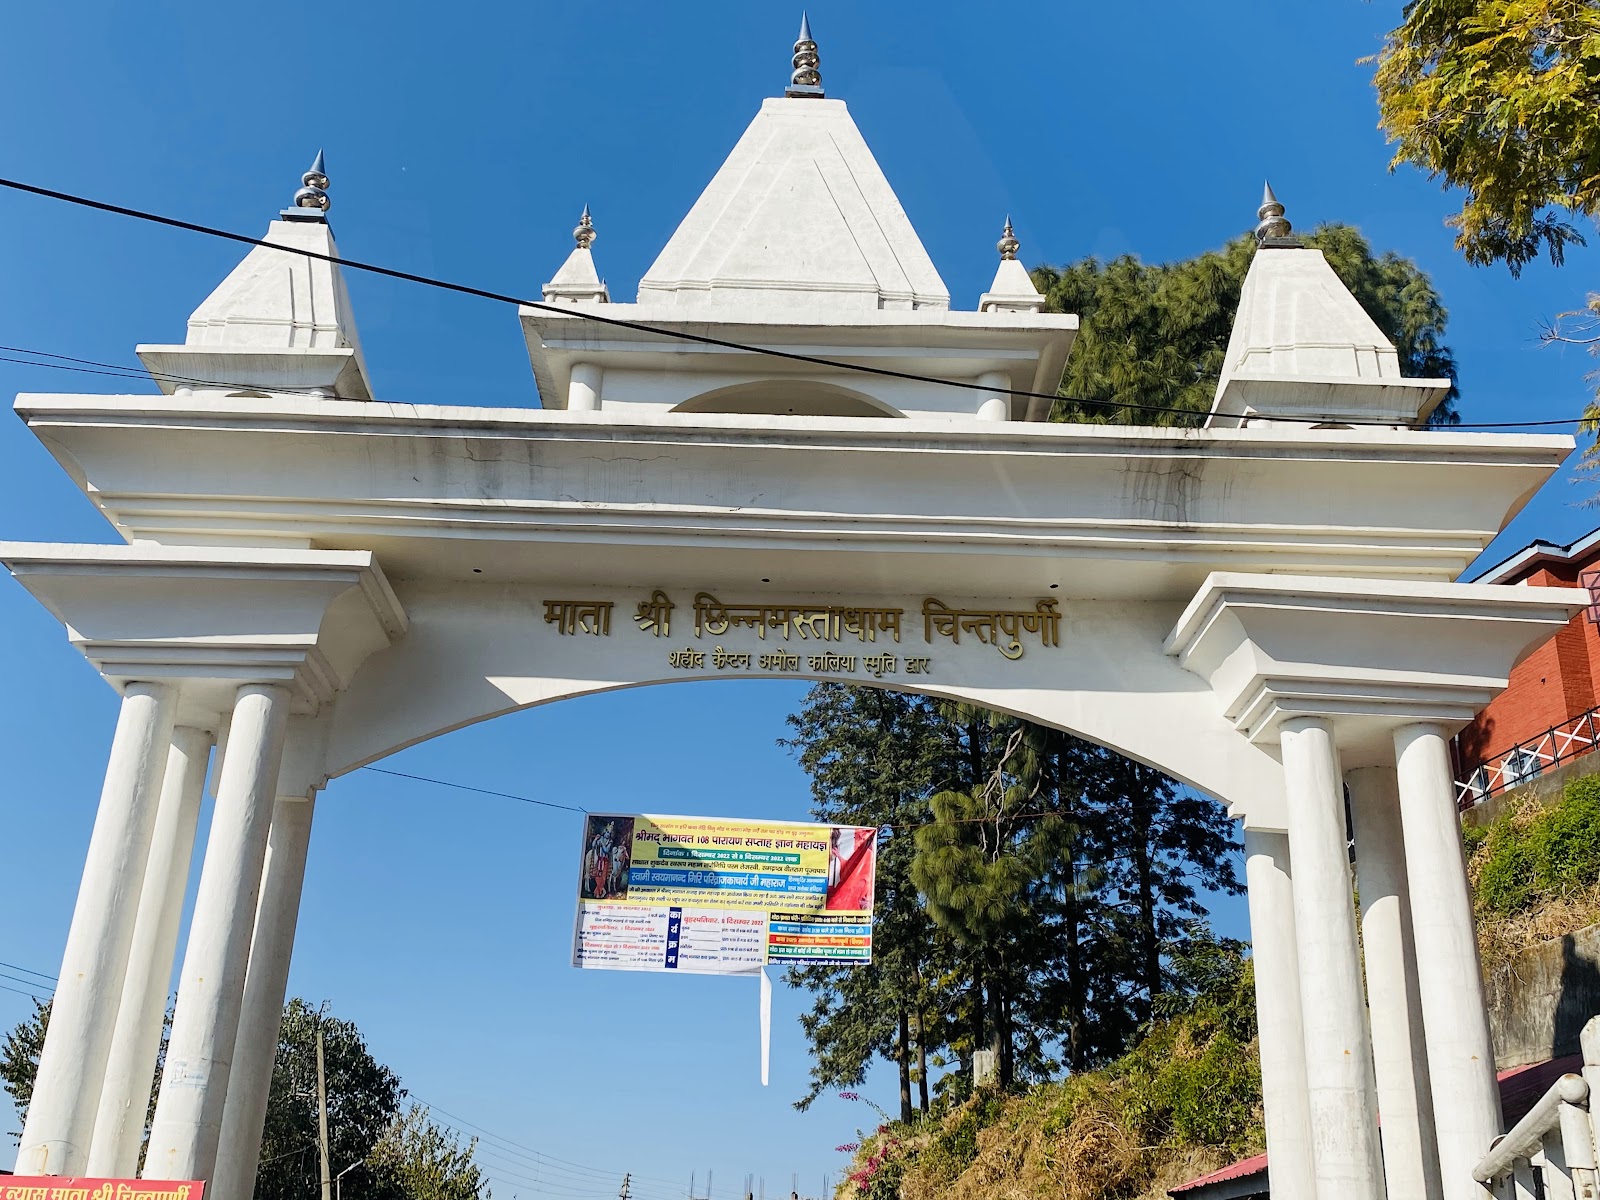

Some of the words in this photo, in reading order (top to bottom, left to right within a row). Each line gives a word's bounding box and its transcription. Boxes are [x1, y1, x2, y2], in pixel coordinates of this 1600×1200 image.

[543, 600, 614, 635] माता
[633, 590, 674, 637] श्री
[669, 646, 705, 668] शहीद
[712, 645, 751, 670] कैप्टन
[758, 648, 800, 671] अमोल
[808, 650, 856, 672] कालिया
[863, 651, 898, 677] स्मृति
[904, 655, 931, 674] द्वार
[636, 829, 661, 845] श्रीमद्
[663, 833, 694, 843] भागवत
[697, 835, 709, 844] 108
[712, 836, 742, 846] पारायण
[745, 837, 773, 848] सप्ताह
[775, 838, 793, 849] ज्ञान
[796, 840, 827, 851] महायज्ञ
[663, 848, 685, 857] दिनांक
[631, 869, 650, 882] स्वामी
[688, 871, 703, 884] गिरि
[749, 874, 759, 886] जी
[760, 878, 786, 888] महाराज
